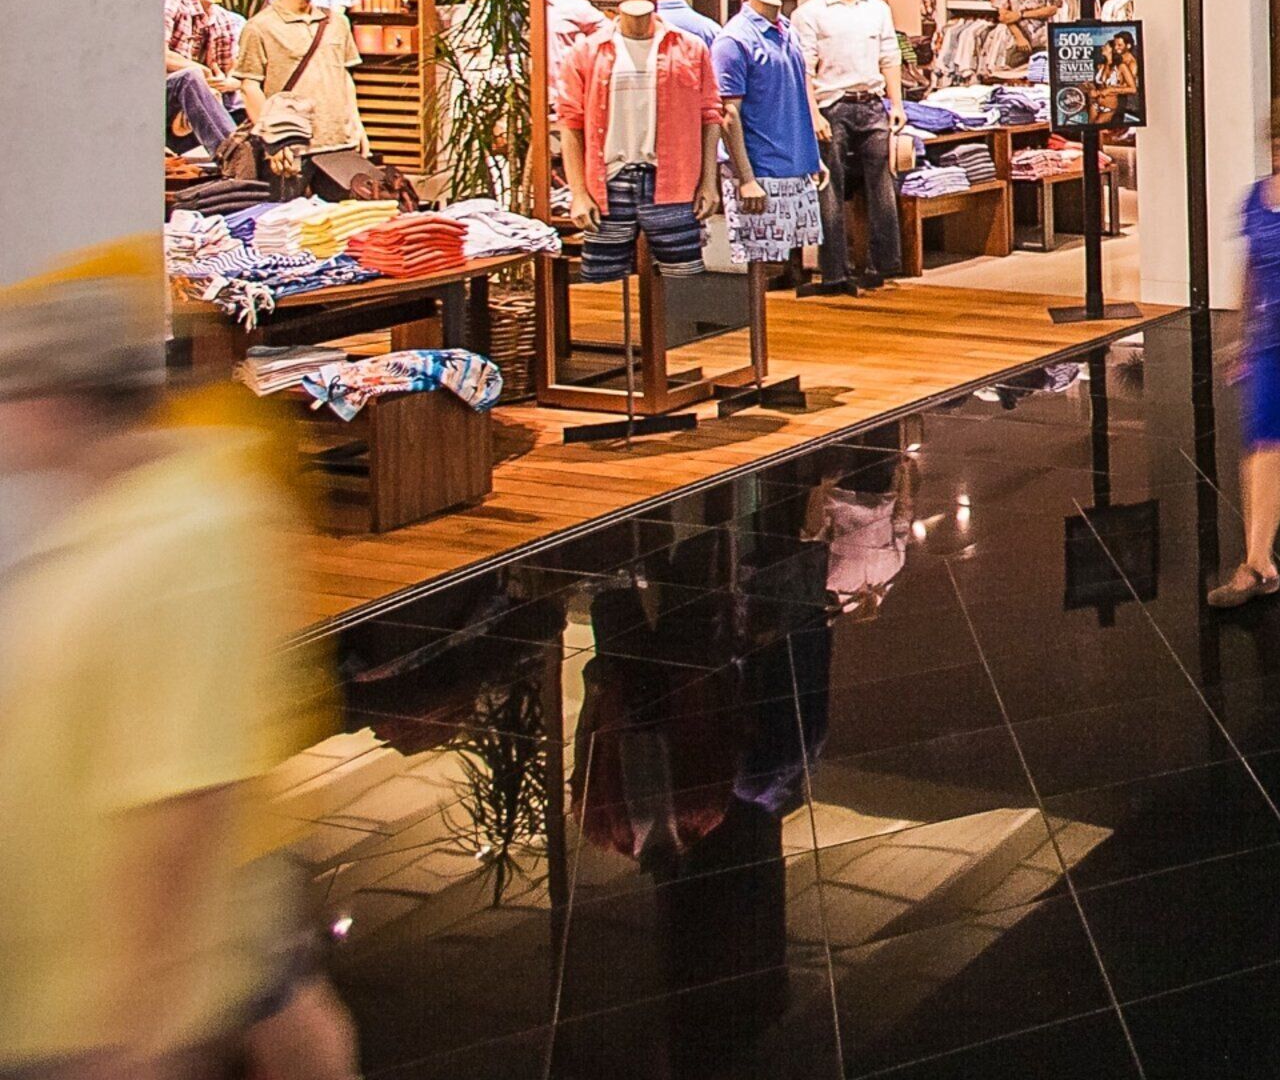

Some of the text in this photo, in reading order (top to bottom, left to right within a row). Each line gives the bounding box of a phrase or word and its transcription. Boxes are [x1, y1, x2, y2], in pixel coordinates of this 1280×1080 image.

[1059, 33, 1093, 46] 50%
[1058, 46, 1094, 59] OFF
[1059, 63, 1094, 72] SWIM
